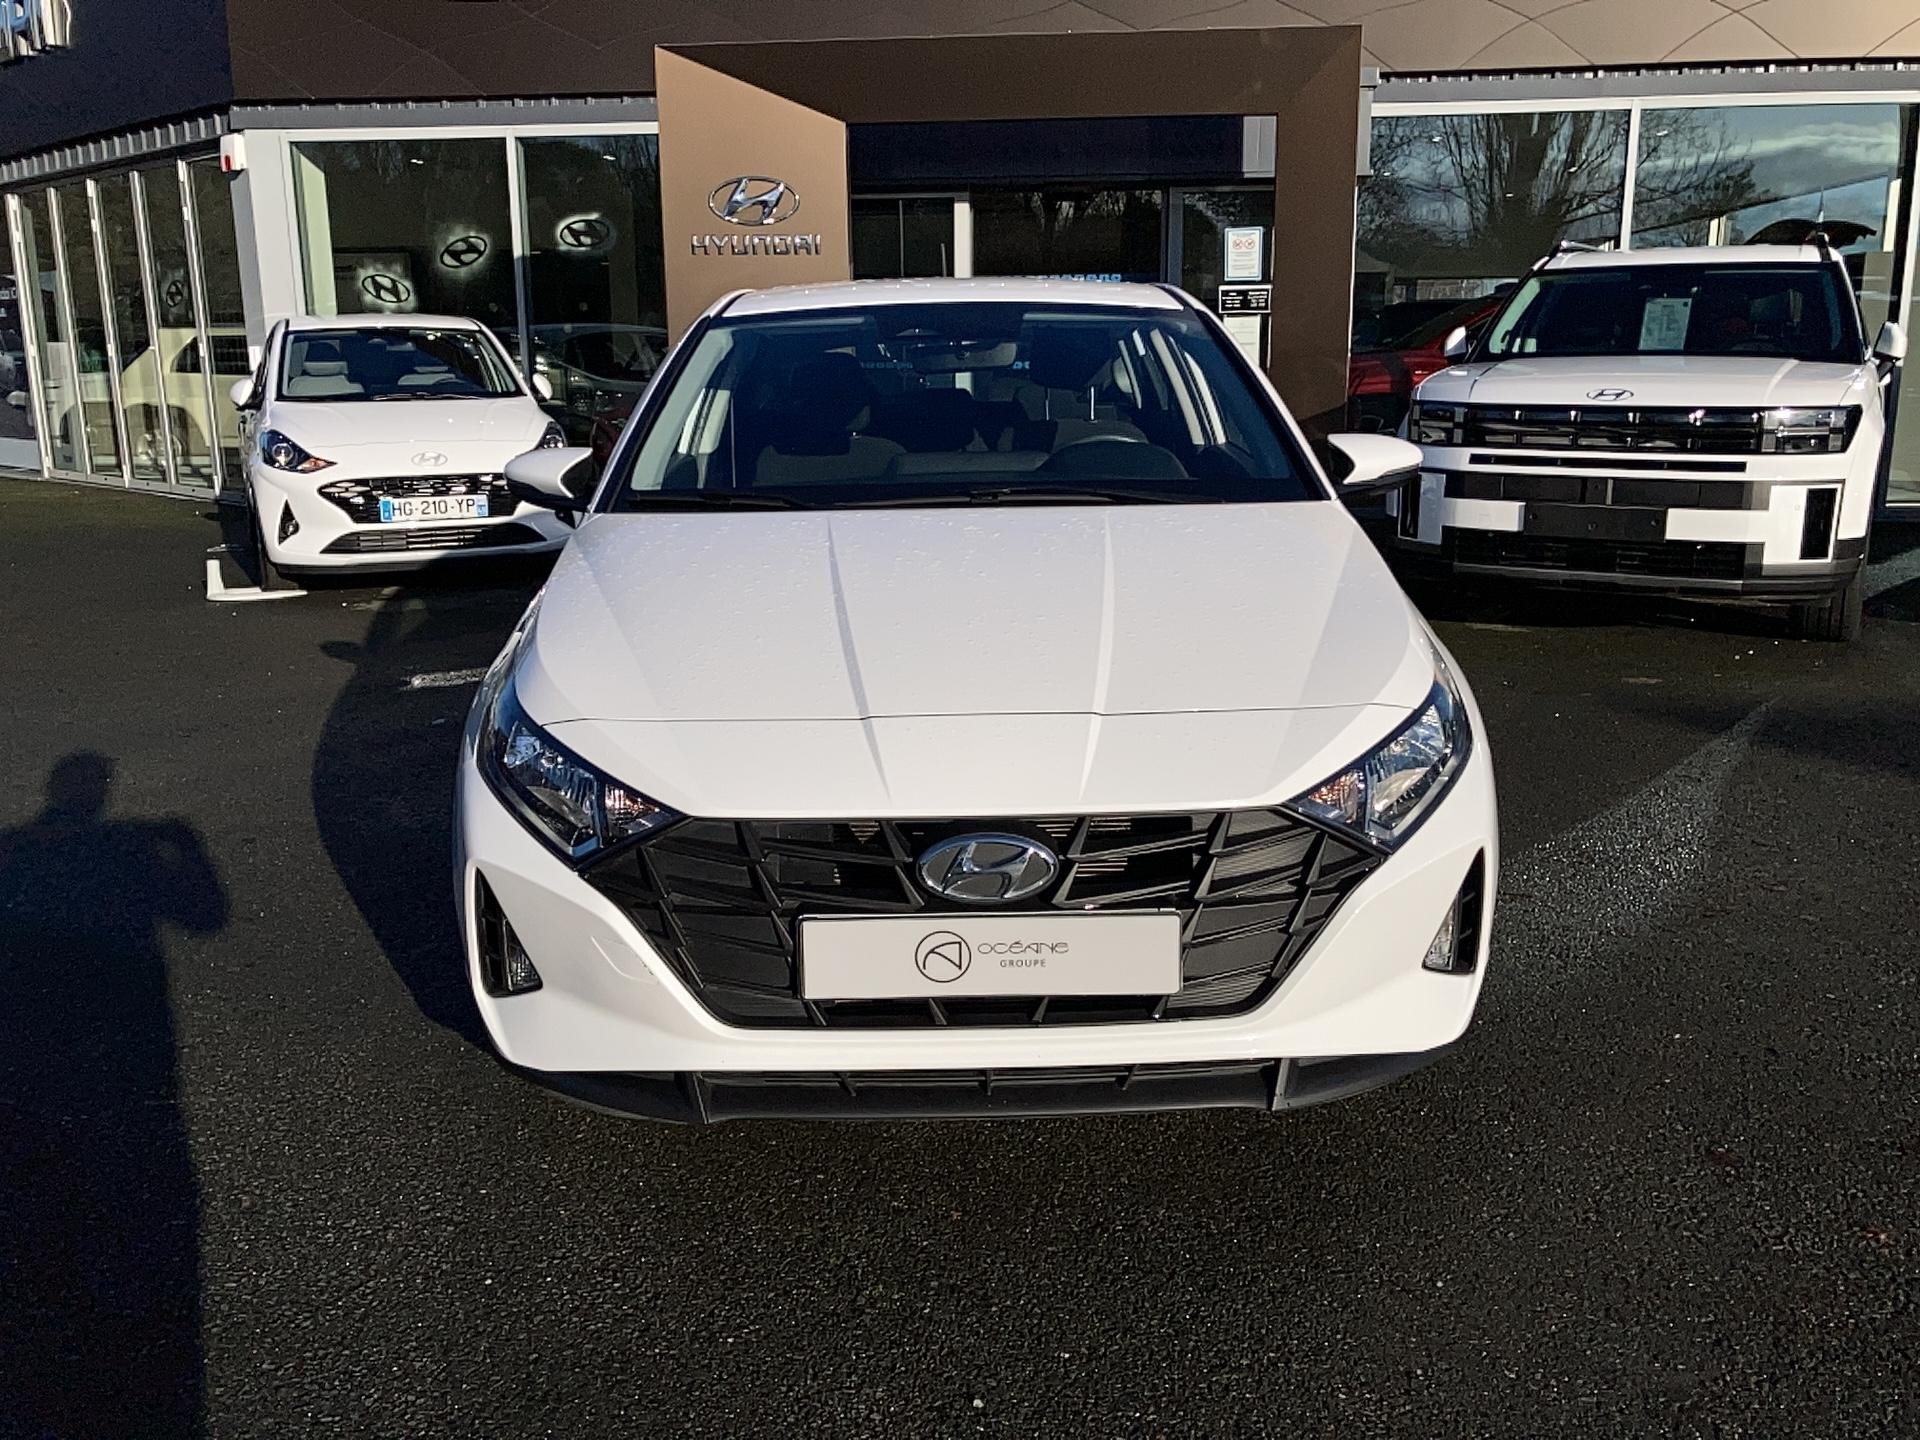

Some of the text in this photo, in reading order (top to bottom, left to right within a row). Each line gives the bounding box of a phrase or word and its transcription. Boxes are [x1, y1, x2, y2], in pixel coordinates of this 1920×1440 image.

[691, 233, 821, 255] HYUNDAI
[391, 498, 475, 517] HG-210-YP
[1000, 958, 1046, 968] GROUPE
